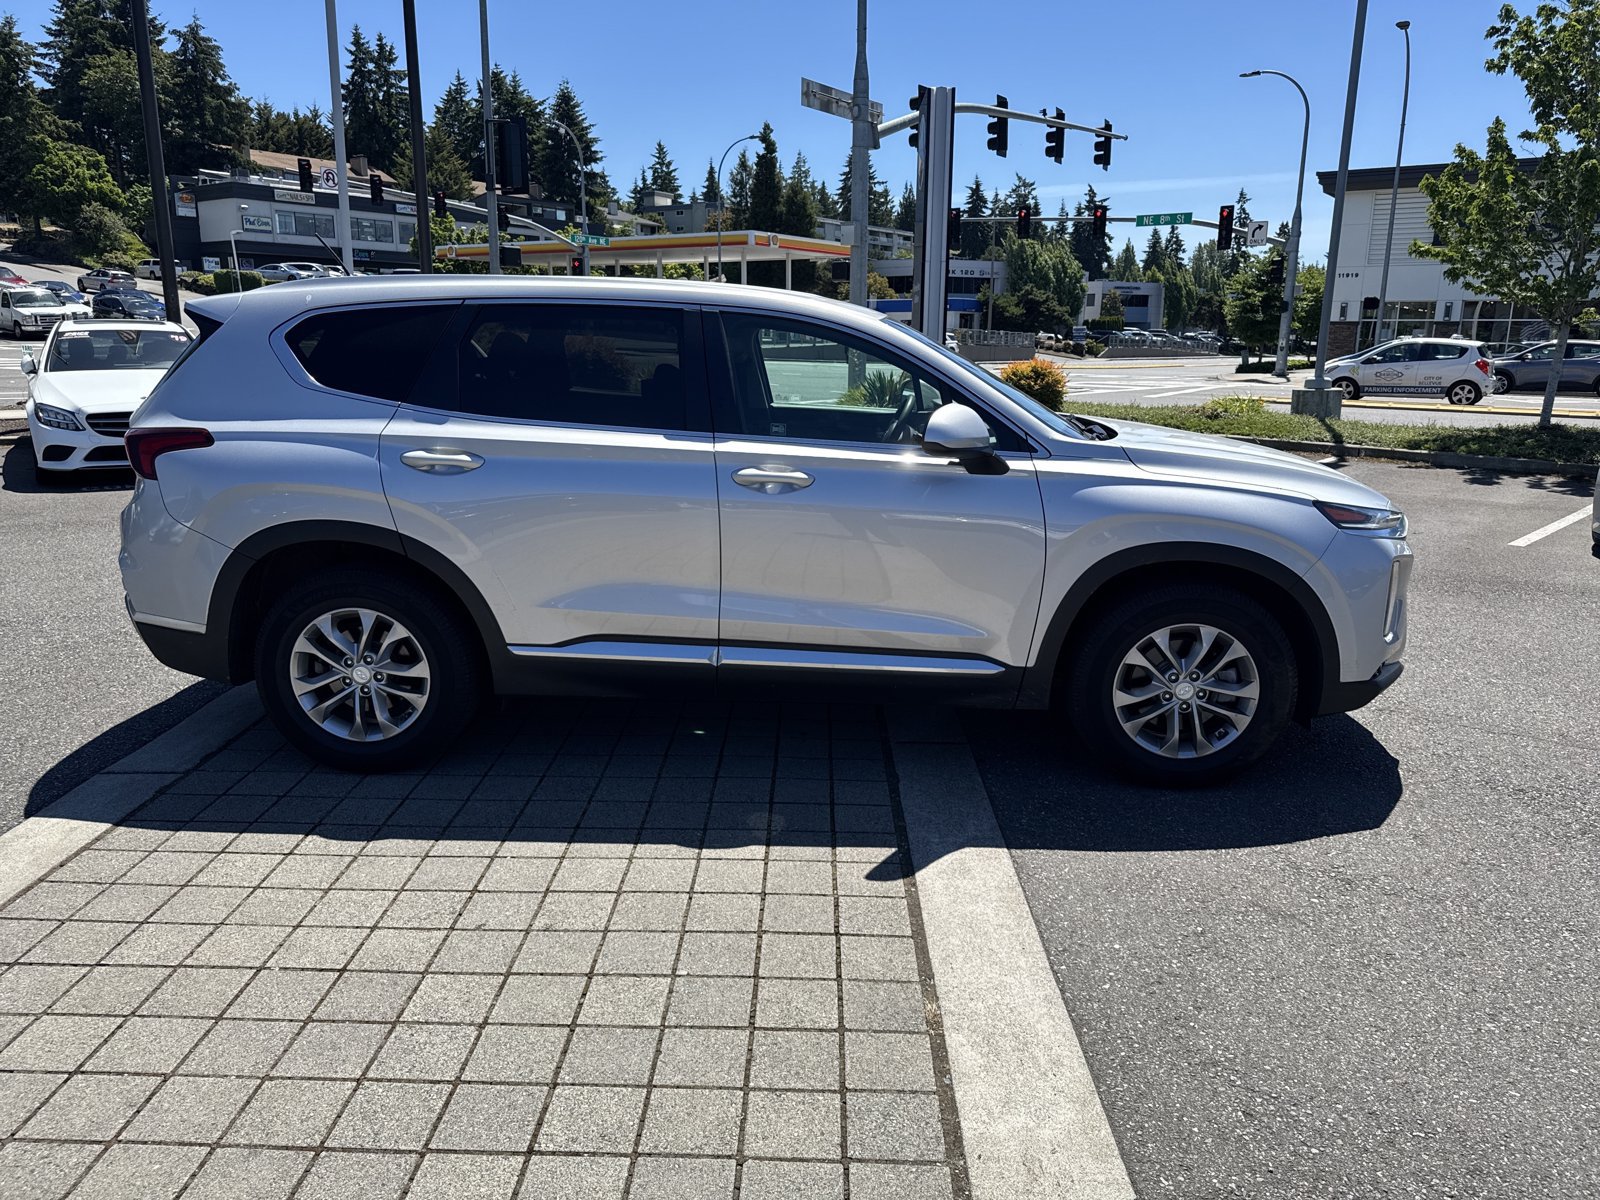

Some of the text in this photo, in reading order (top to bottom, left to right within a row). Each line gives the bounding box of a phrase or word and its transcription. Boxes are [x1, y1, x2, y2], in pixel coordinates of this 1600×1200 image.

[1143, 214, 1185, 225] NE 8th St
[574, 235, 606, 245] 120th Ave NE
